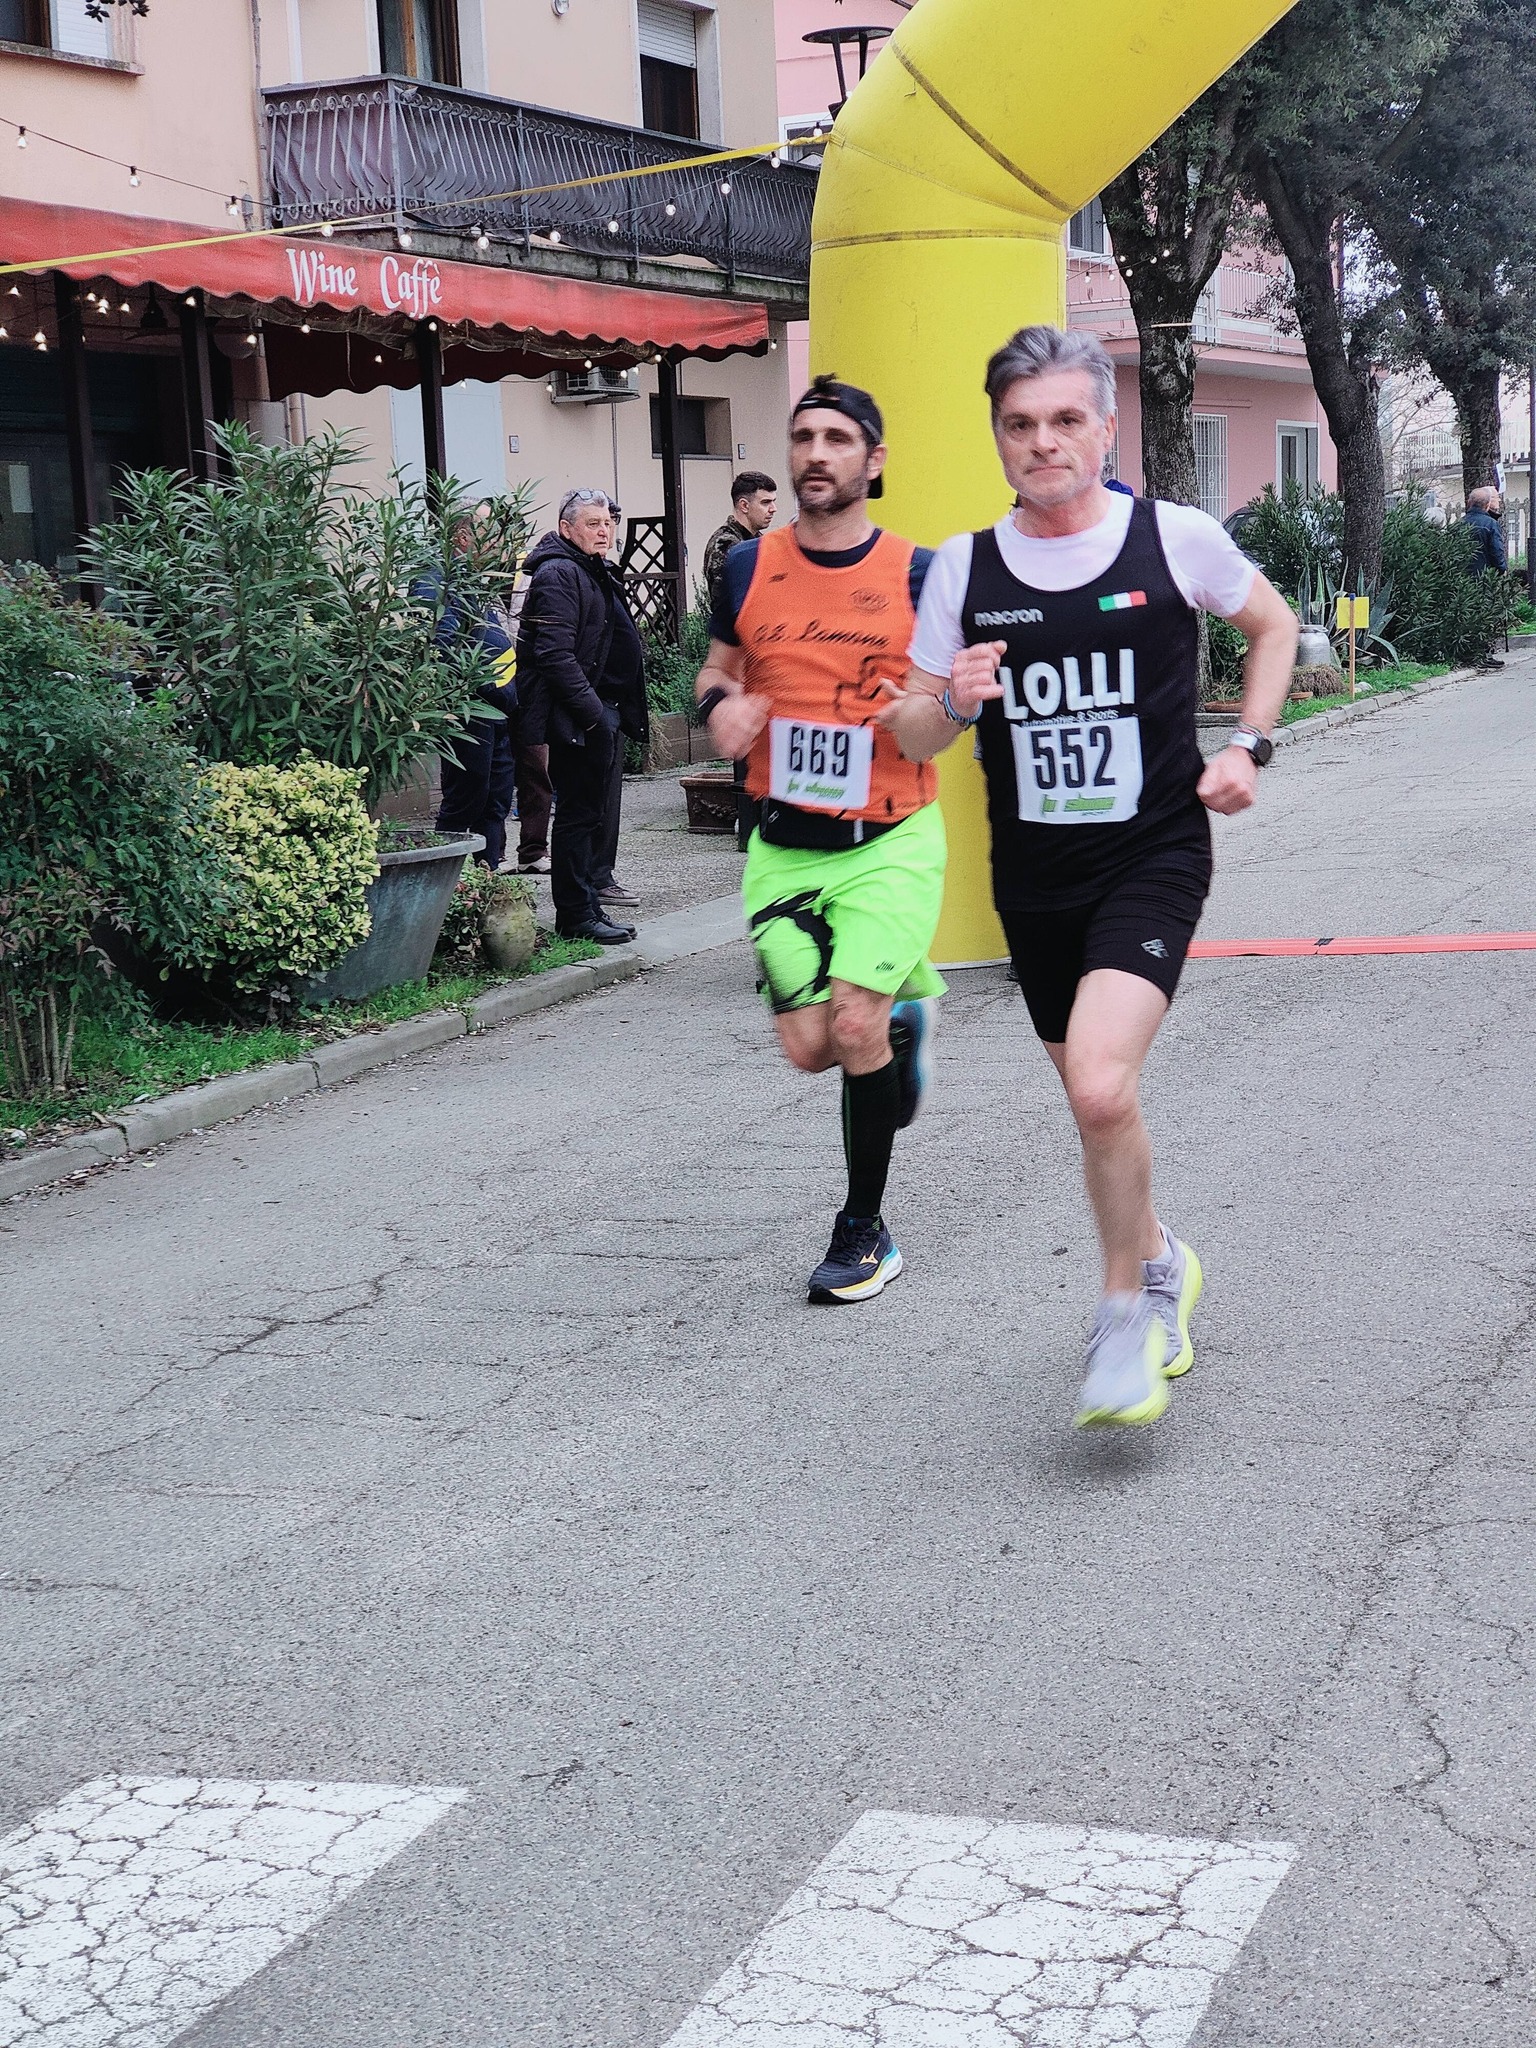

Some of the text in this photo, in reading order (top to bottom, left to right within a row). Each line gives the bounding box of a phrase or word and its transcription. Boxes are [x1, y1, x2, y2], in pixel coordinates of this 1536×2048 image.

[286, 248, 442, 319] Wine Caffè
[974, 608, 1044, 627] macron
[998, 648, 1135, 720] LOLLI
[789, 725, 850, 777] 669
[1030, 725, 1116, 790] 552
